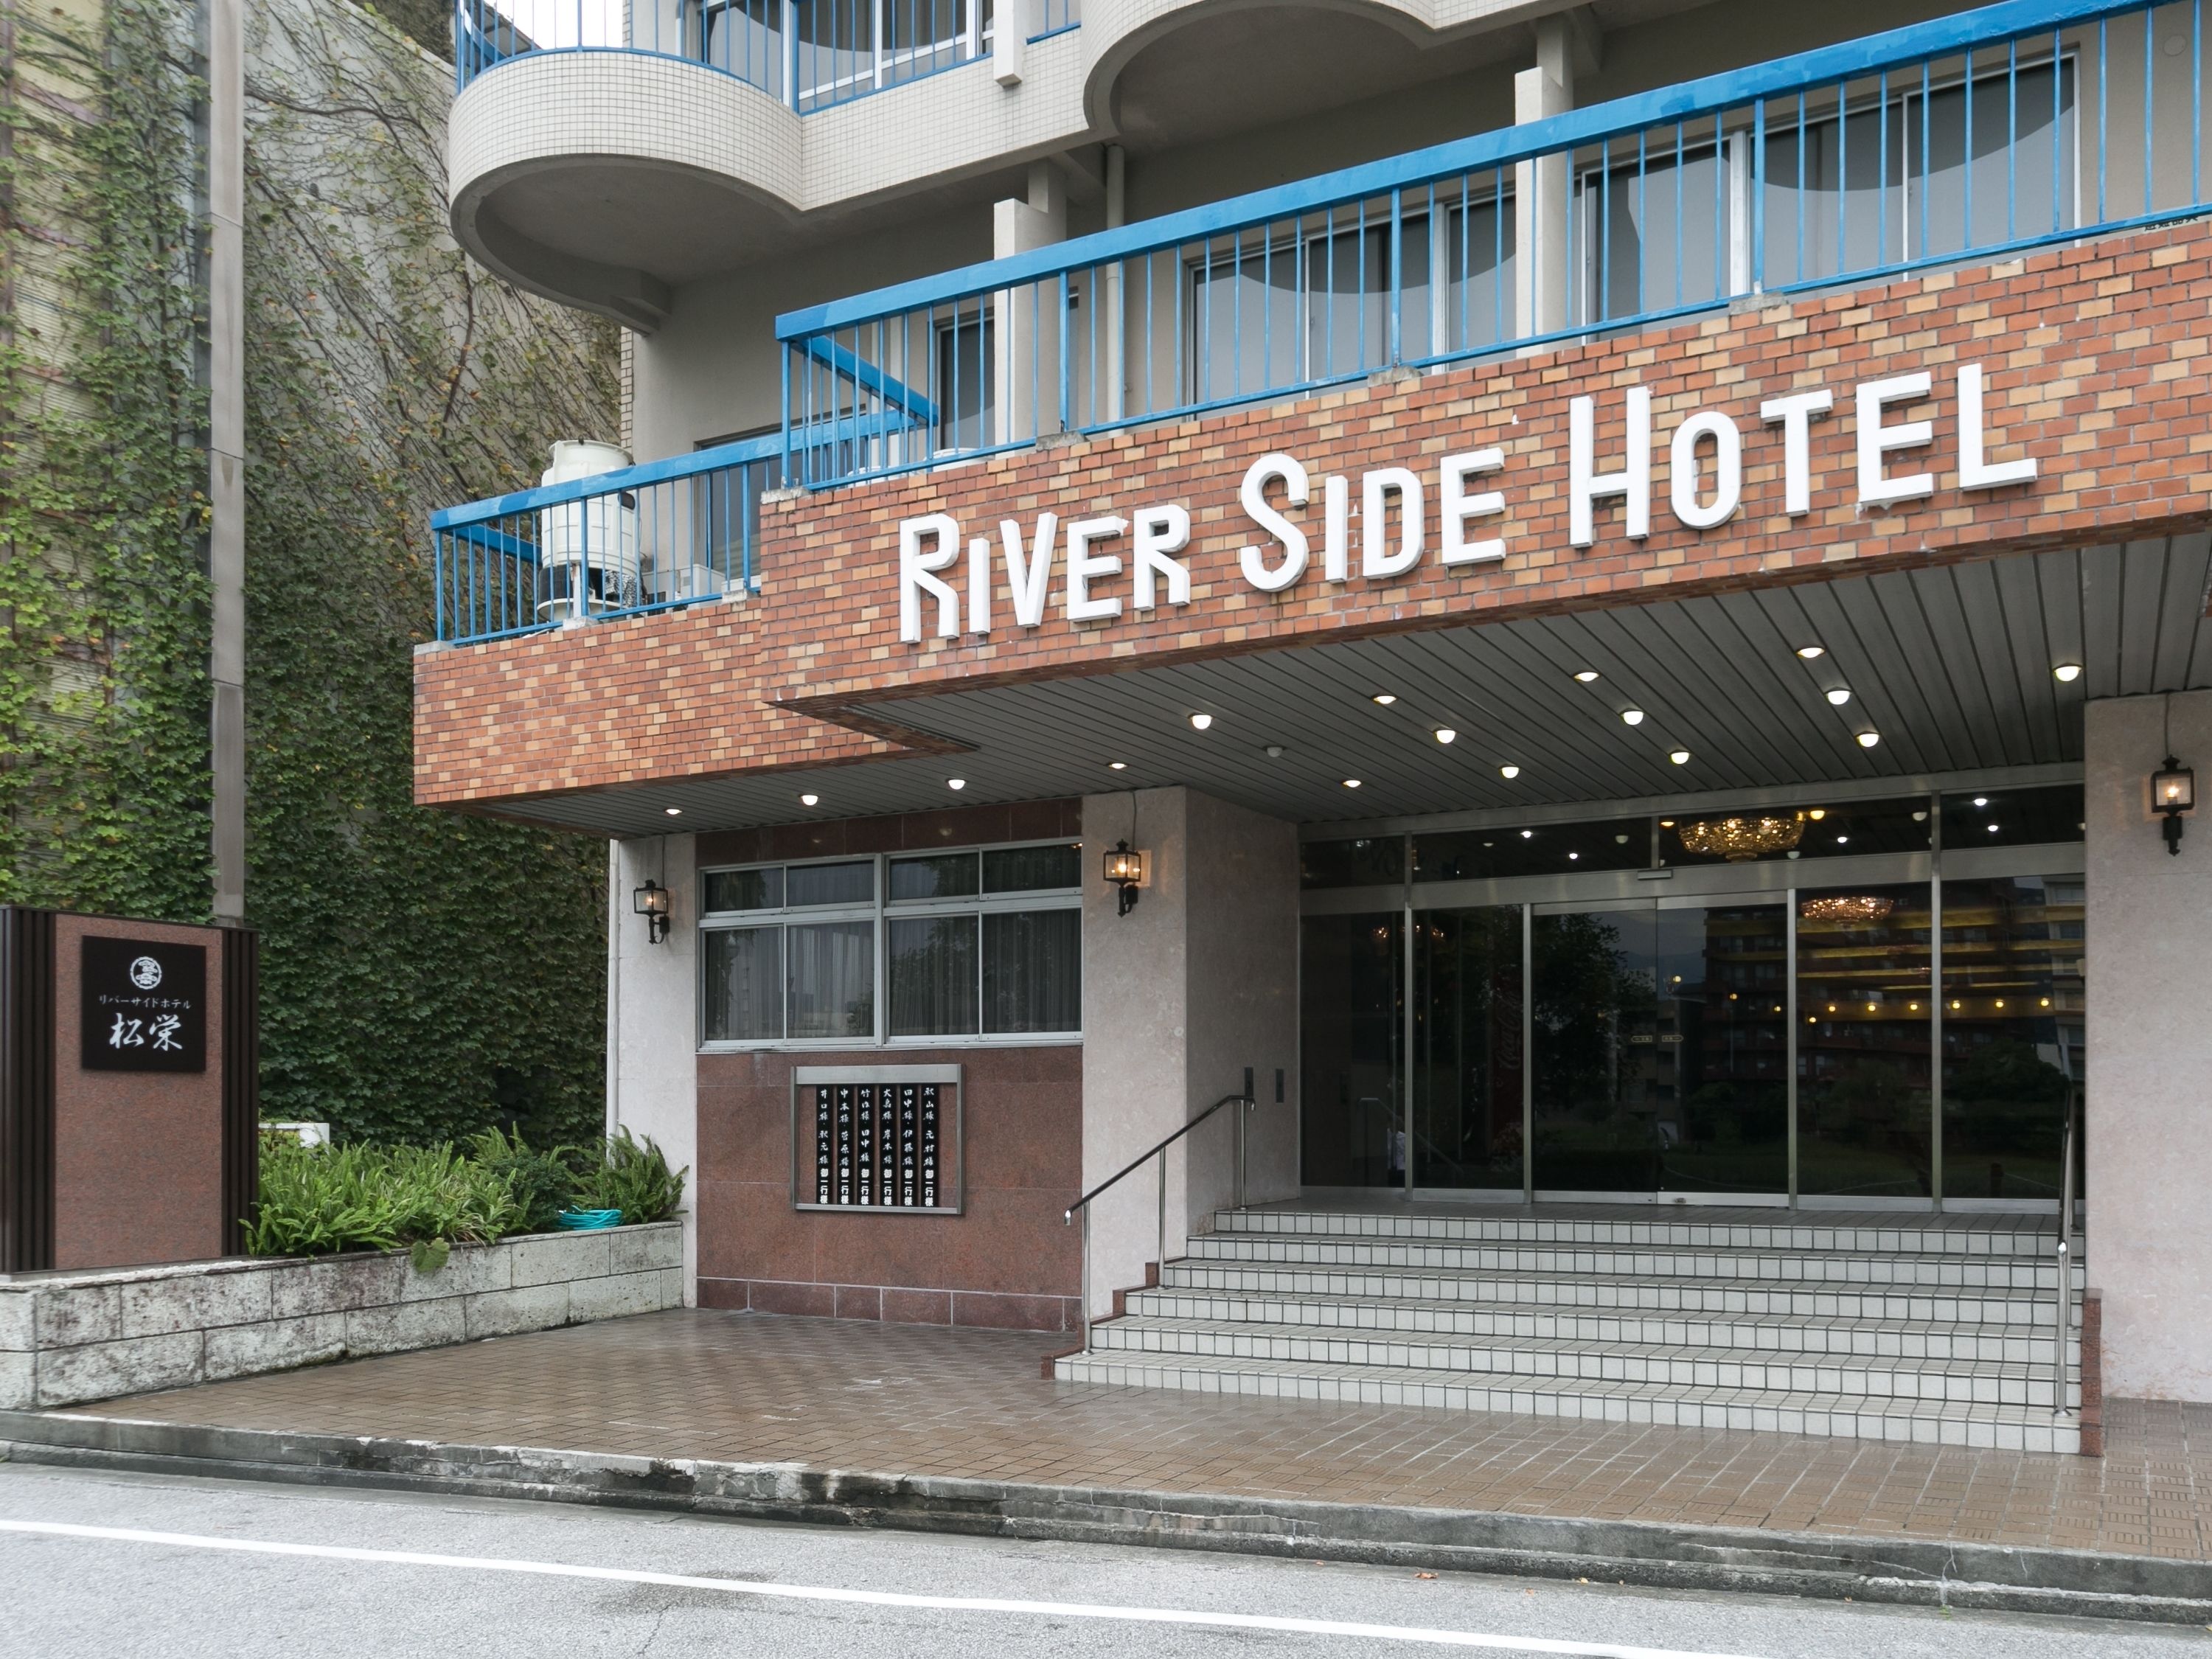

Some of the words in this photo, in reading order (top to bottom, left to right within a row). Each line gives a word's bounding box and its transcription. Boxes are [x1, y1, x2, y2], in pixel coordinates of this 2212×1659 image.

[900, 504, 1192, 644] RIVER
[1240, 447, 1506, 592] SIDE
[1570, 363, 2038, 549] HOTEL
[99, 995, 192, 1009] リバーサイドホテル
[109, 1012, 183, 1051] 松栄
